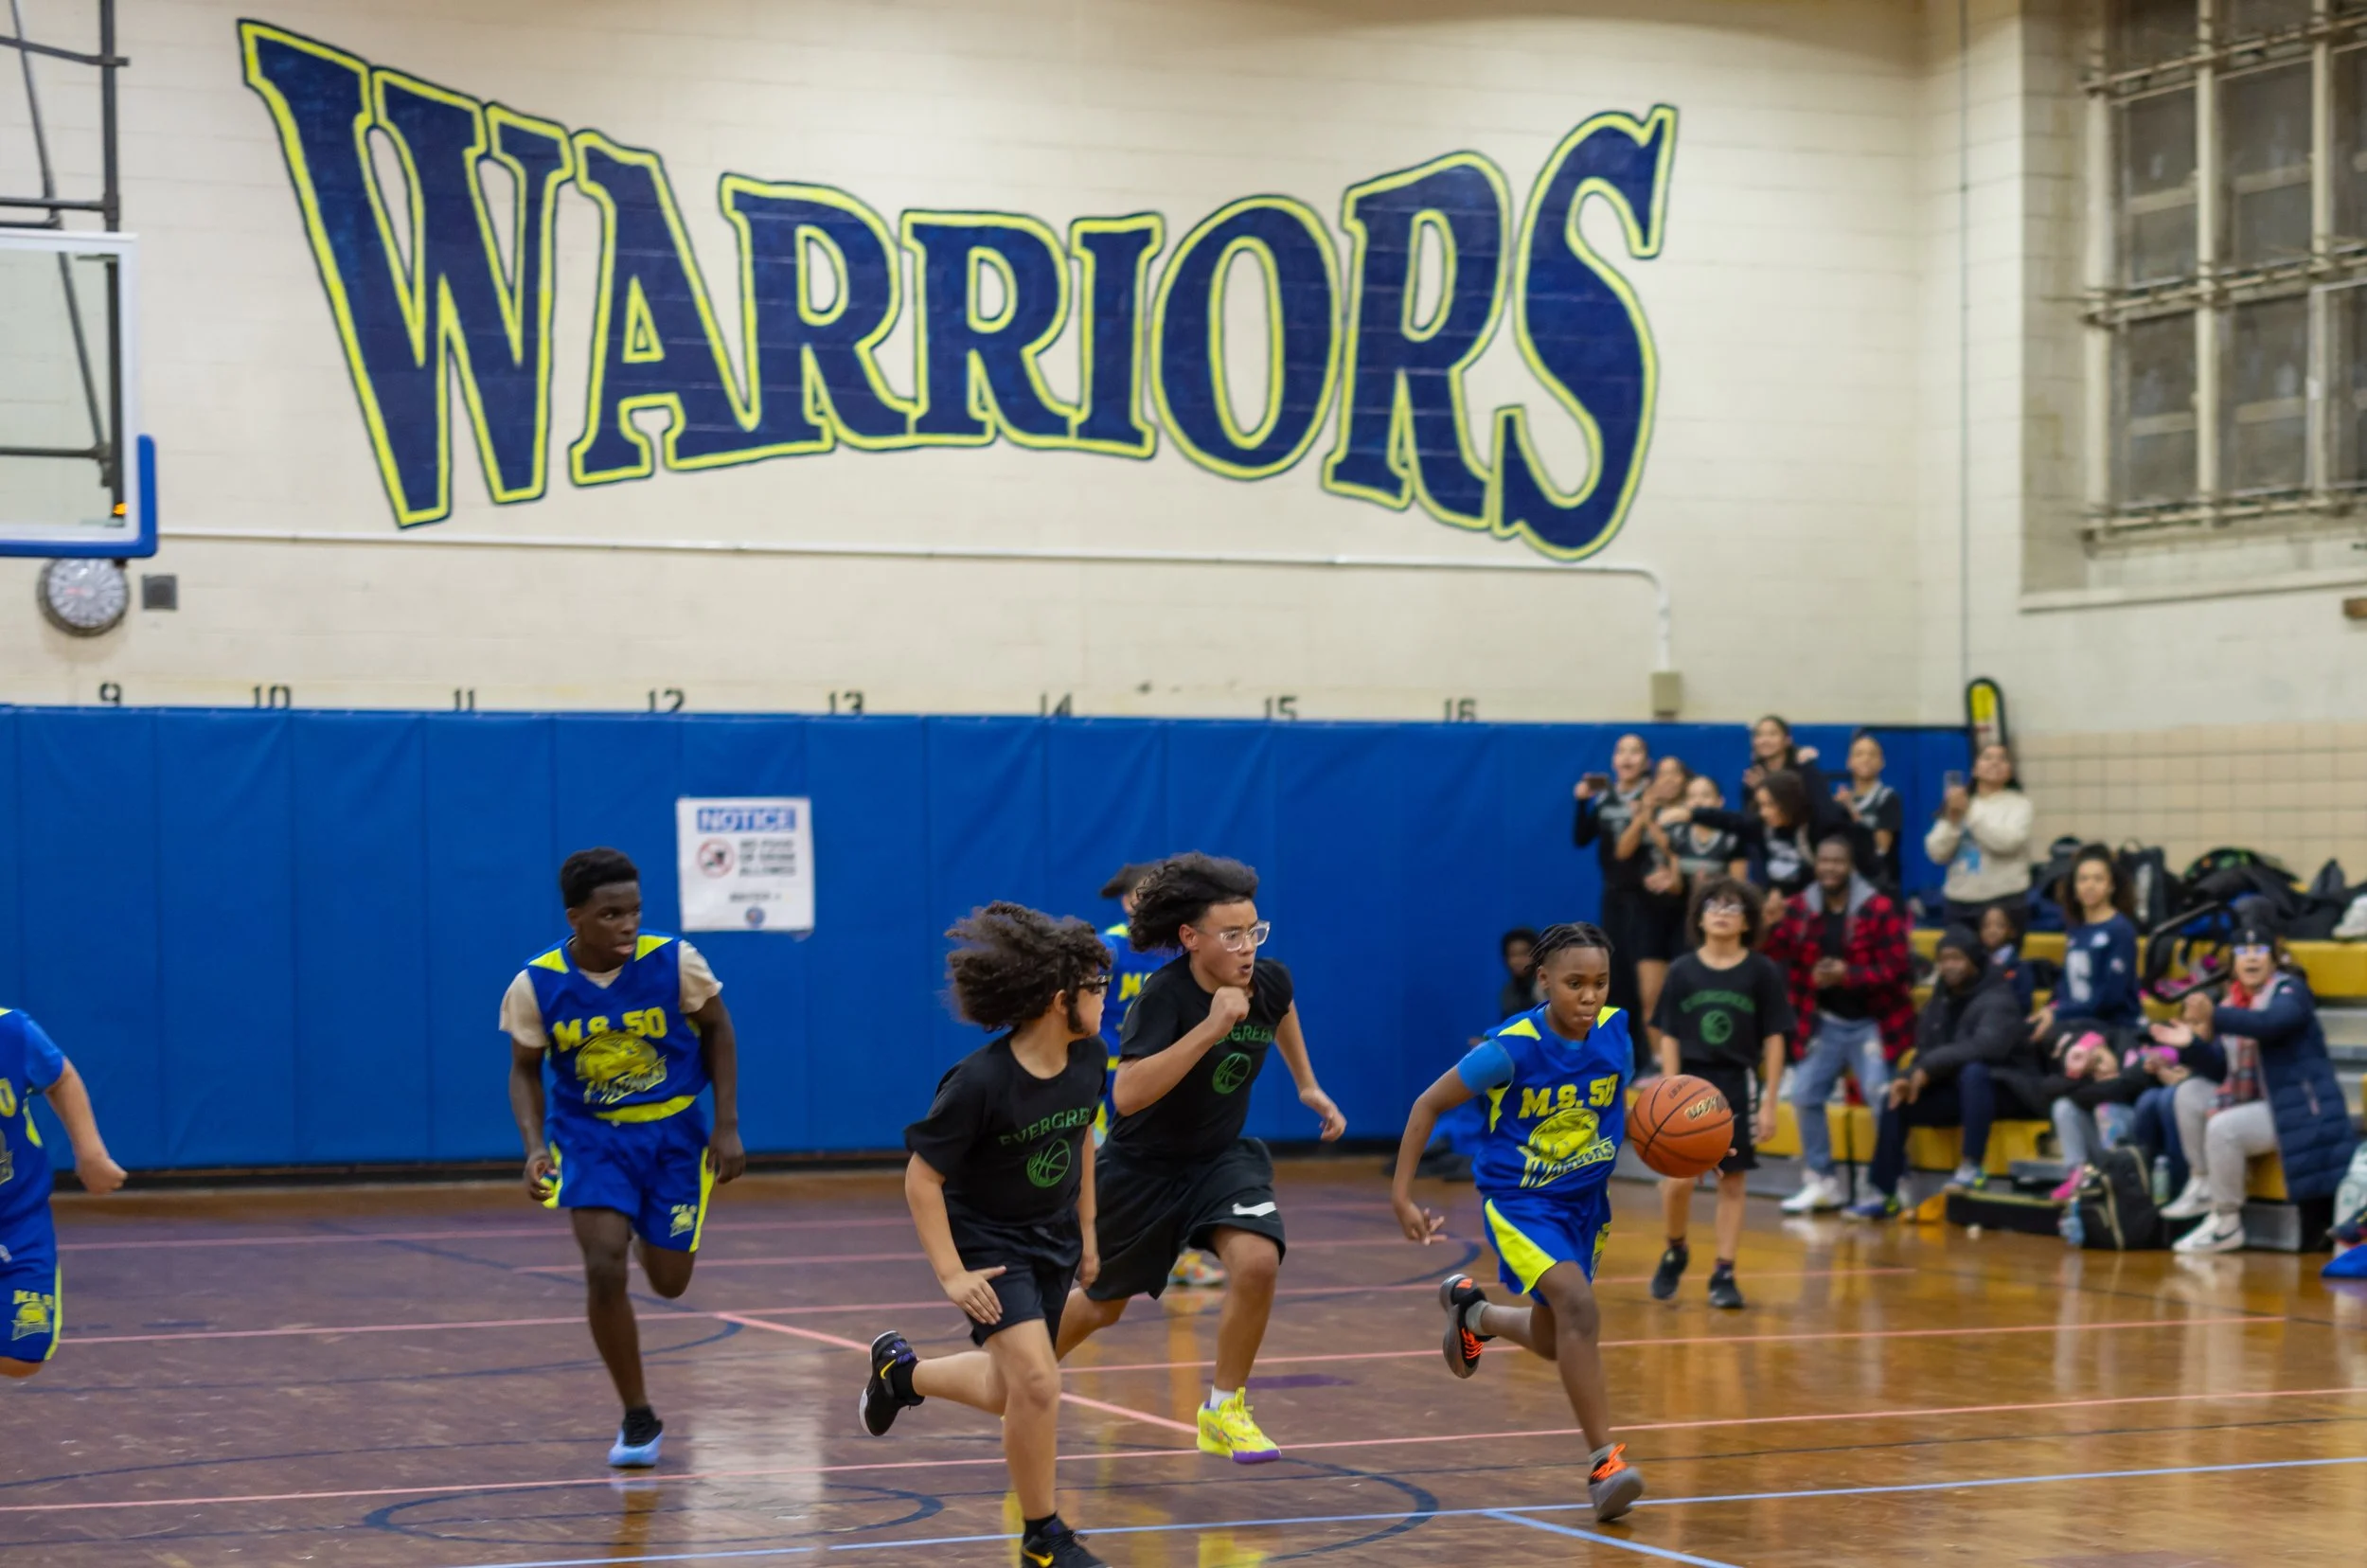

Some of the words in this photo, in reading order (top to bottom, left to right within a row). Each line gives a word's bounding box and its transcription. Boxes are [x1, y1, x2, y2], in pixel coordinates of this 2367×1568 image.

[240, 19, 1678, 561] WARRIORS
[98, 683, 121, 706] 9
[252, 686, 292, 708] 10
[454, 688, 475, 711] 11
[645, 688, 685, 713] 12
[828, 691, 864, 714] 13
[1040, 692, 1074, 716] 14
[1264, 696, 1298, 721] 15
[701, 811, 792, 831] NOTICE
[622, 1007, 667, 1038] 50
[1519, 1084, 1584, 1118] M.S.
